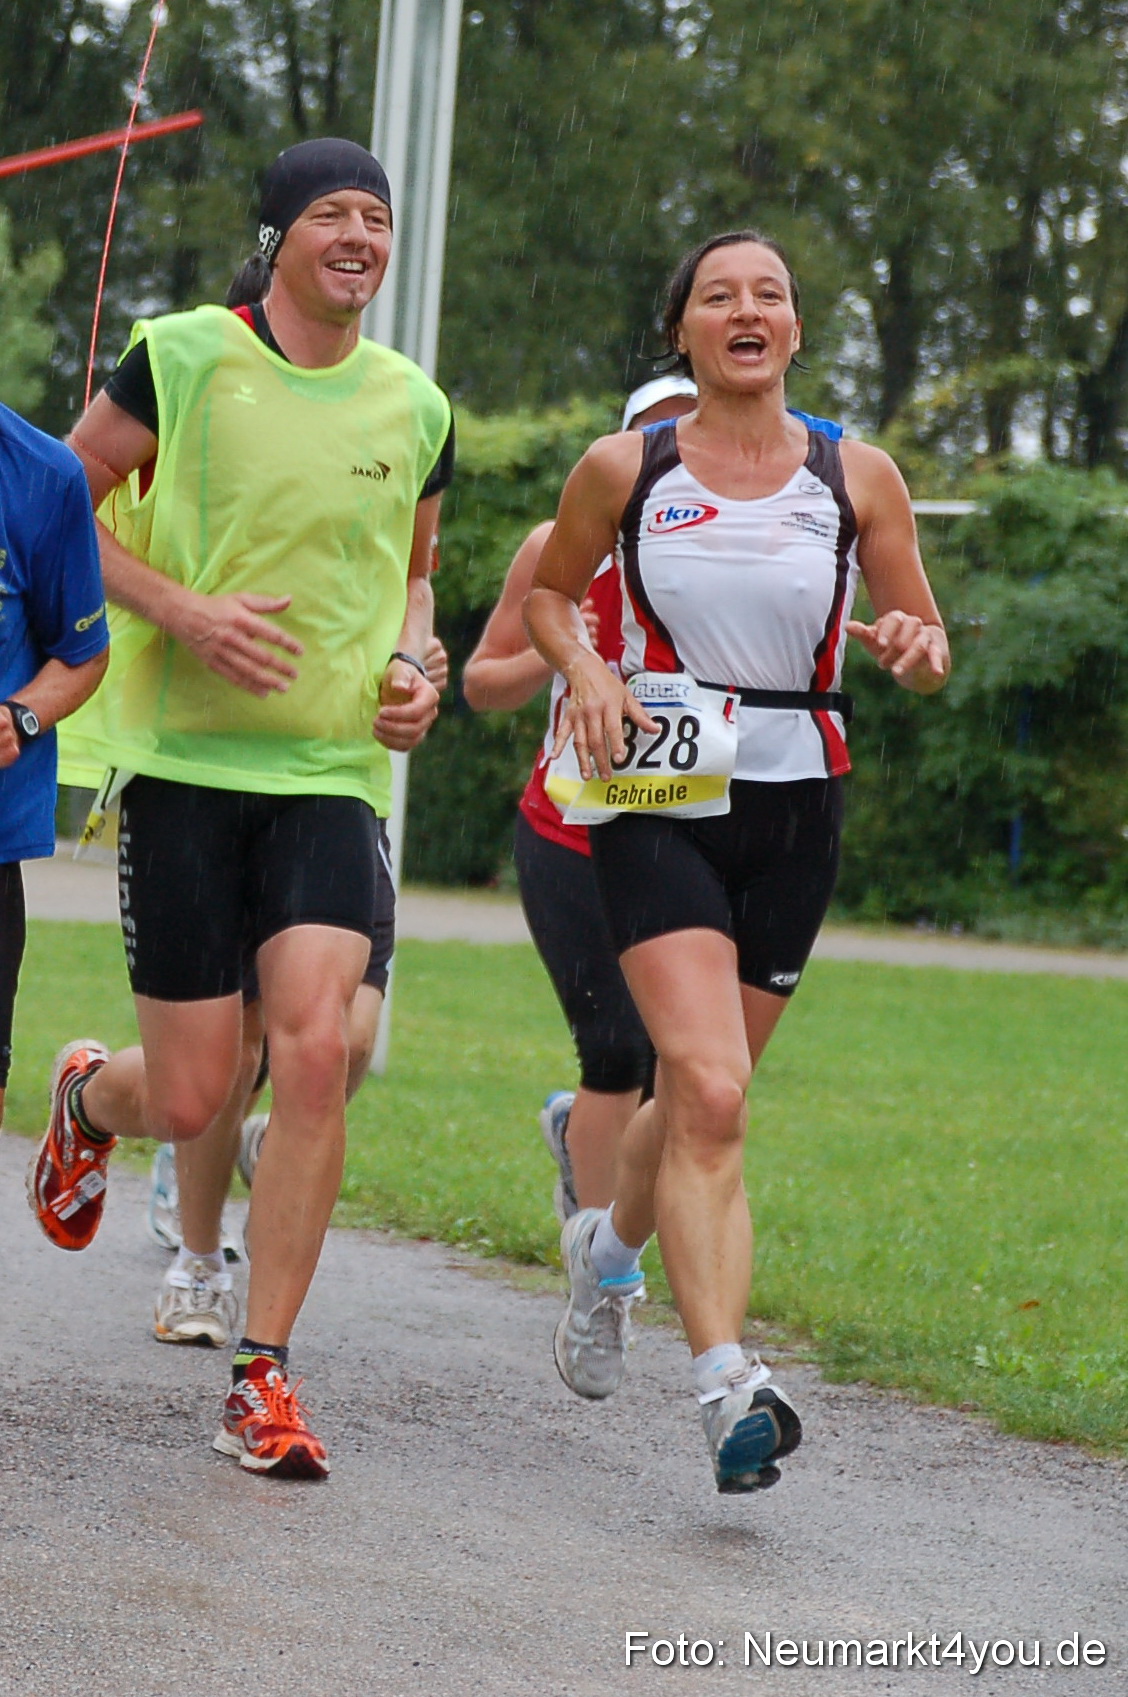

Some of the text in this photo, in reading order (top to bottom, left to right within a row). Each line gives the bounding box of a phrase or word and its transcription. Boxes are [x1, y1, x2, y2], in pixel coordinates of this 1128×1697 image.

[350, 464, 381, 481] JAKO
[655, 506, 700, 524] tkn
[605, 784, 688, 805] Gabriele
